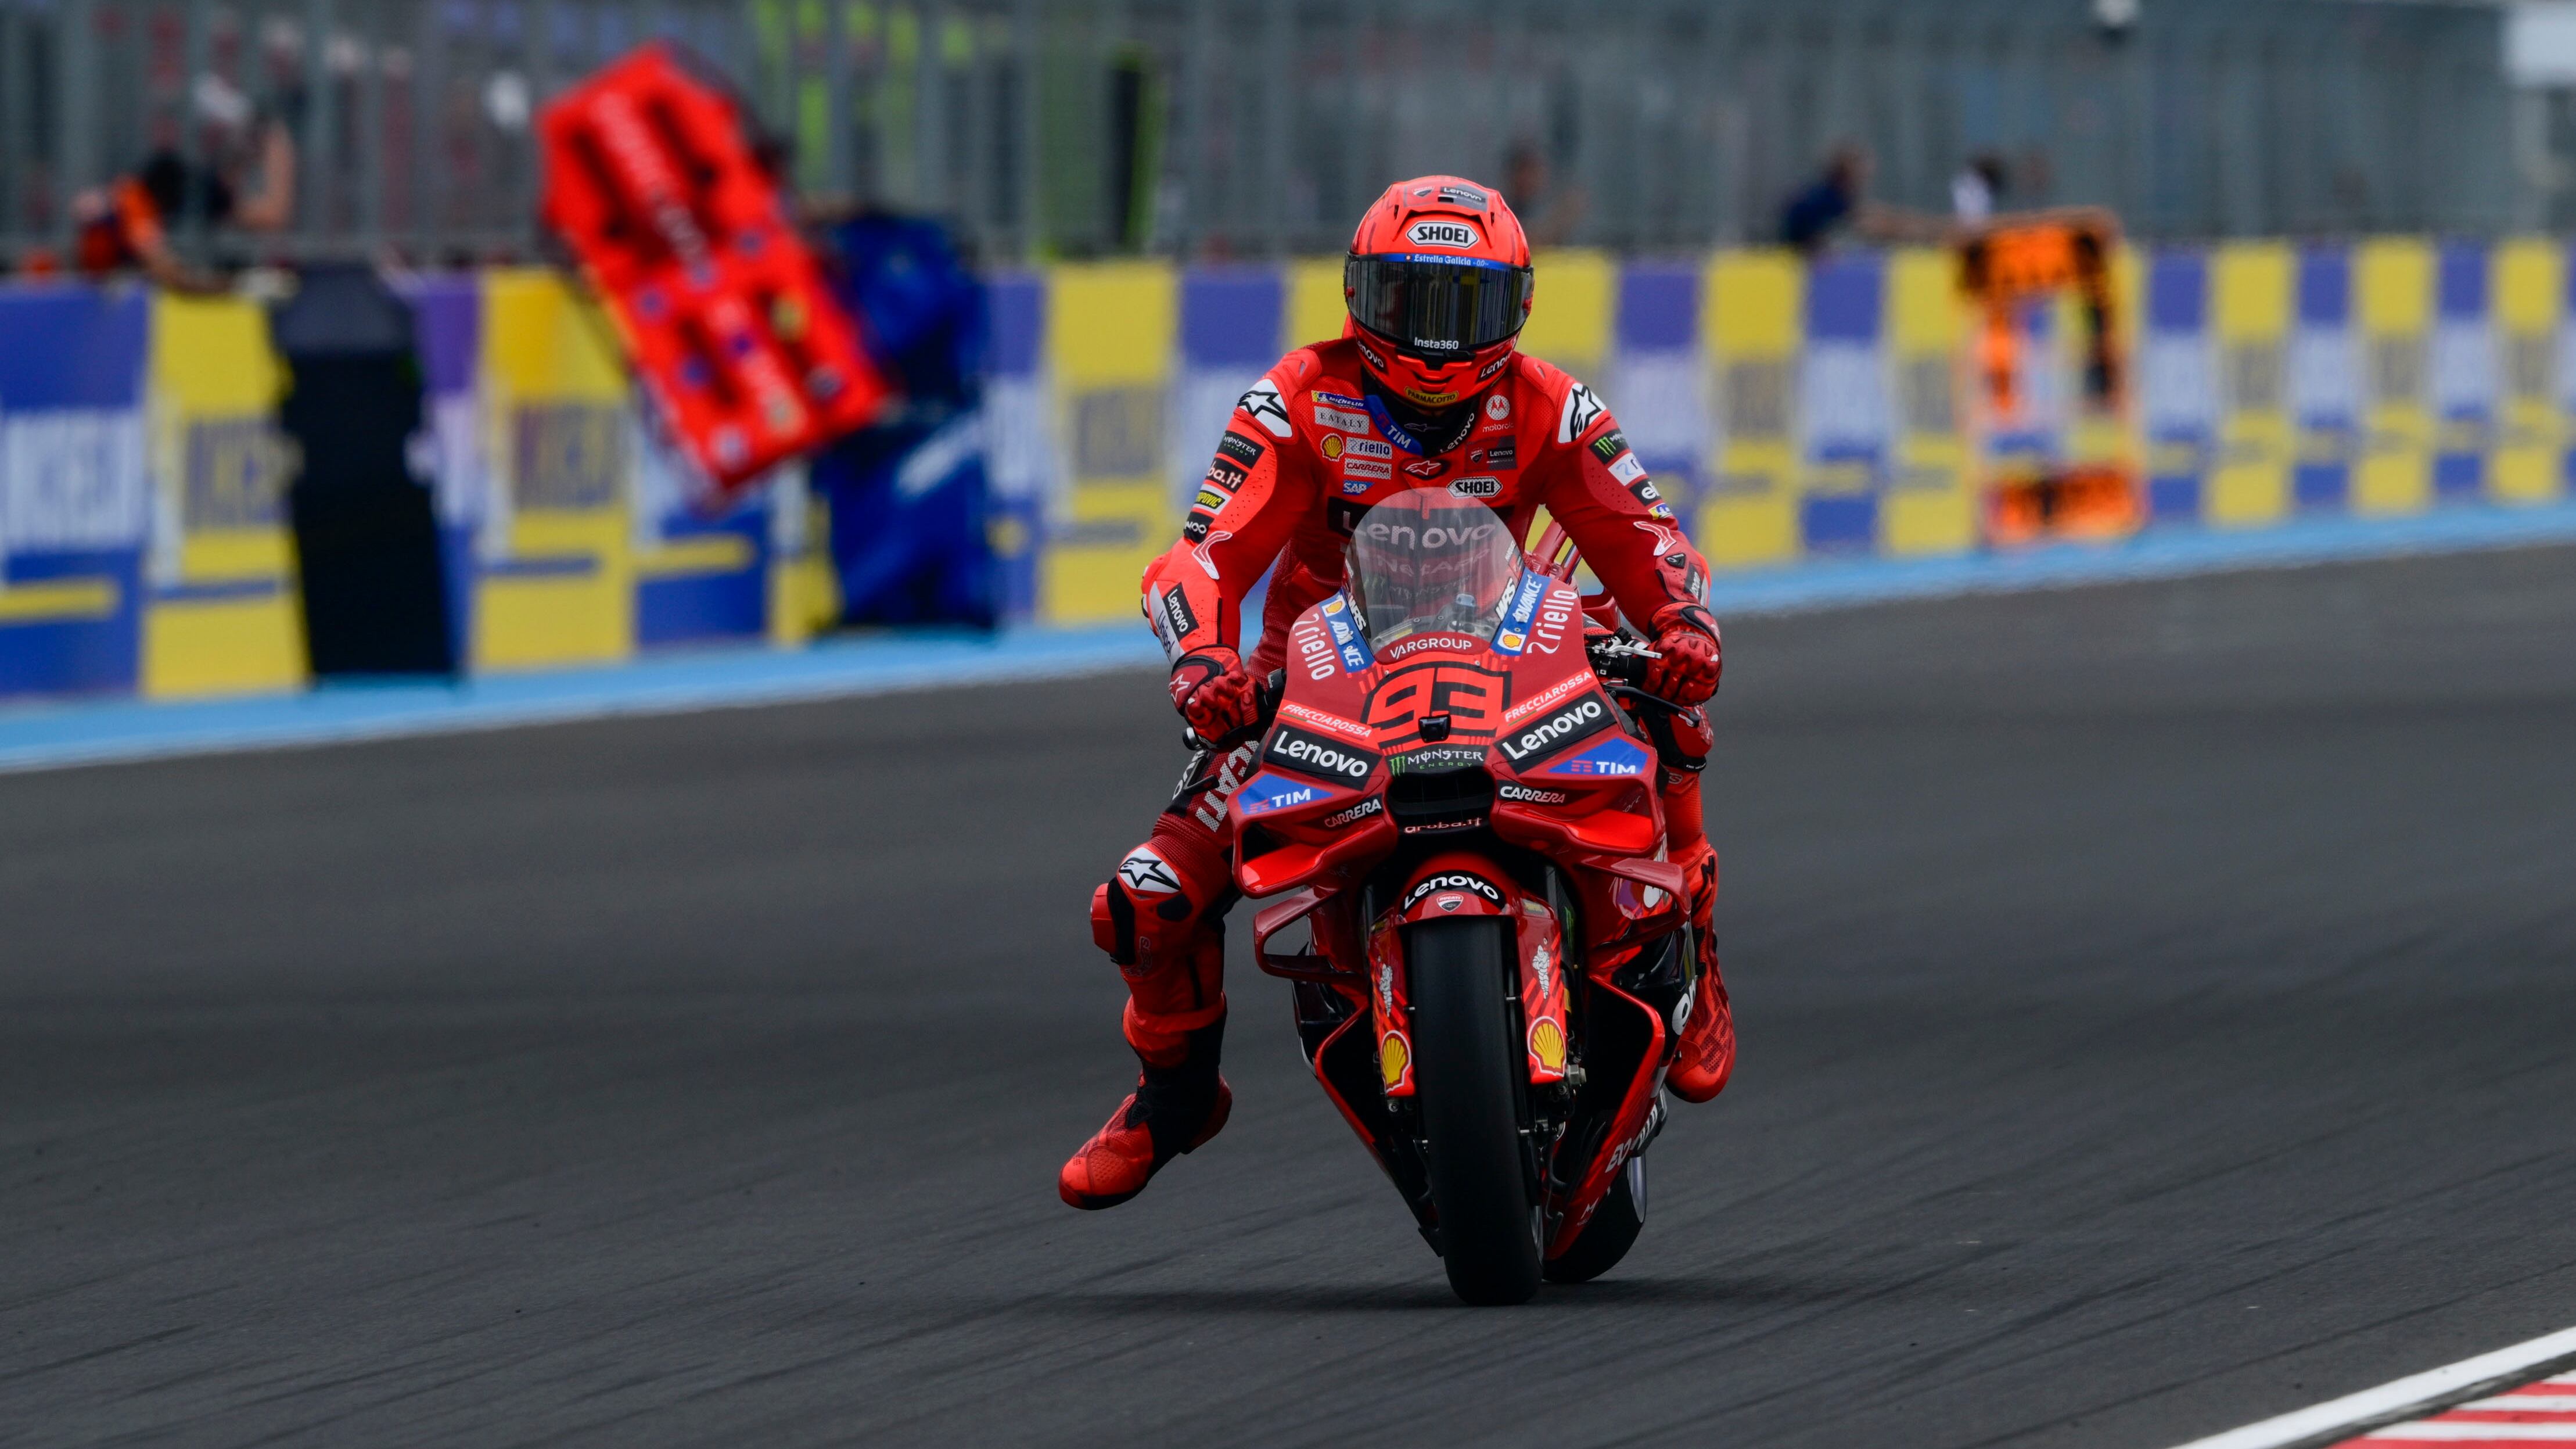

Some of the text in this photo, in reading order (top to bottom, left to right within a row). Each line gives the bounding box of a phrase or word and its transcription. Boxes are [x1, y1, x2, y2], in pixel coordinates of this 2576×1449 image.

[1417, 225, 1469, 244] SHOEI
[1414, 254, 1443, 263] Estrella
[1445, 256, 1471, 266] Galicia
[1414, 337, 1459, 350] Insta360
[1329, 396, 1364, 407] MICHELIN
[1407, 389, 1456, 403] PARMACOTTO
[1320, 412, 1363, 428] EATALY
[1387, 425, 1411, 449] TIM
[1440, 413, 1475, 454] Lenovo
[1359, 442, 1390, 455] riello
[1346, 462, 1390, 474] CARRERA
[1343, 483, 1367, 494] SAP
[1342, 511, 1497, 551] Lenovo
[1167, 588, 1188, 633] Lenovo
[1535, 589, 1578, 640] riello
[1295, 626, 1335, 681] riello
[1361, 661, 1512, 749] 93
[1504, 671, 1592, 723] FRECCIAROSSA
[1282, 704, 1373, 738] FRECCIAROSSA
[1502, 701, 1601, 760] Lenovo
[1273, 731, 1368, 777] Lenovo
[1420, 762, 1472, 770] ENERGY
[1596, 761, 1636, 774] TIM
[1272, 788, 1311, 808] TIM
[1500, 786, 1566, 804] CARRERA
[1324, 798, 1382, 828] CARRERA
[1404, 817, 1483, 834] aruba.it
[1404, 875, 1499, 910] Lenovo
